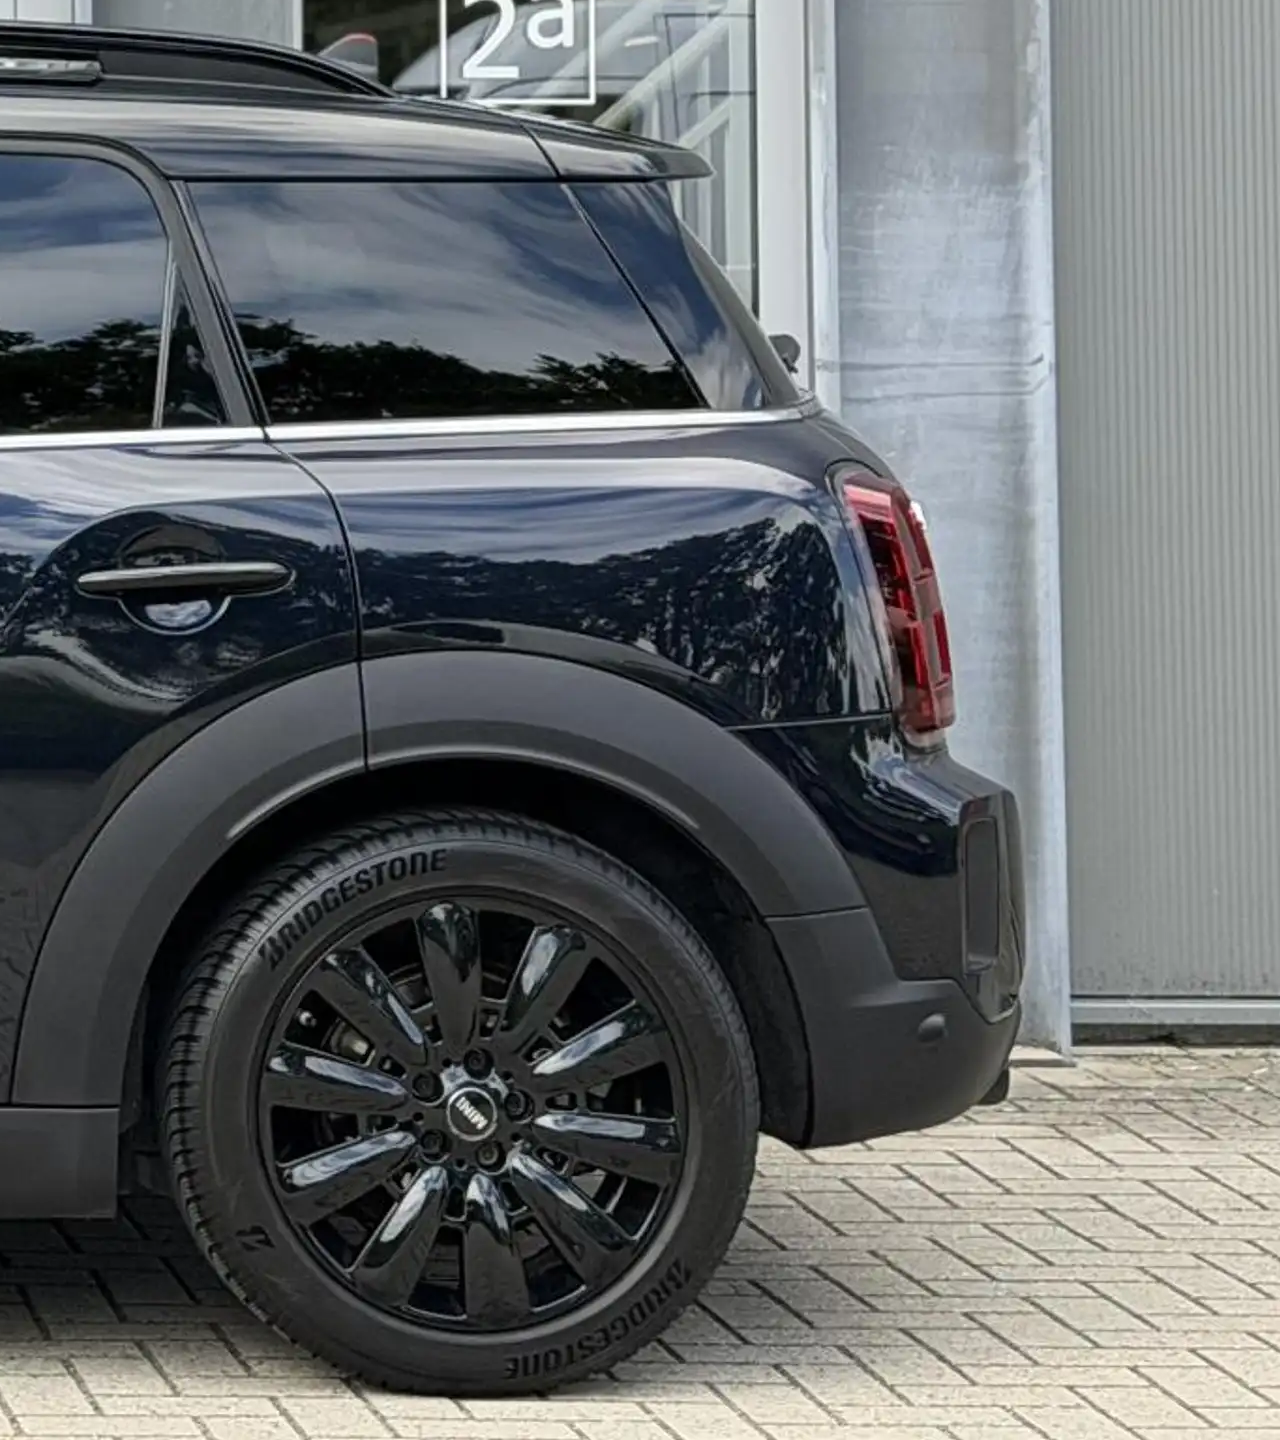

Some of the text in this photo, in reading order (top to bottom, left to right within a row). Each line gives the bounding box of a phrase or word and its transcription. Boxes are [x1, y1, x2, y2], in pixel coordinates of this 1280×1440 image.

[258, 848, 447, 972] BRIDGESTONE
[455, 1095, 489, 1131] MINI
[502, 1257, 691, 1379] BRIDGESTONE
